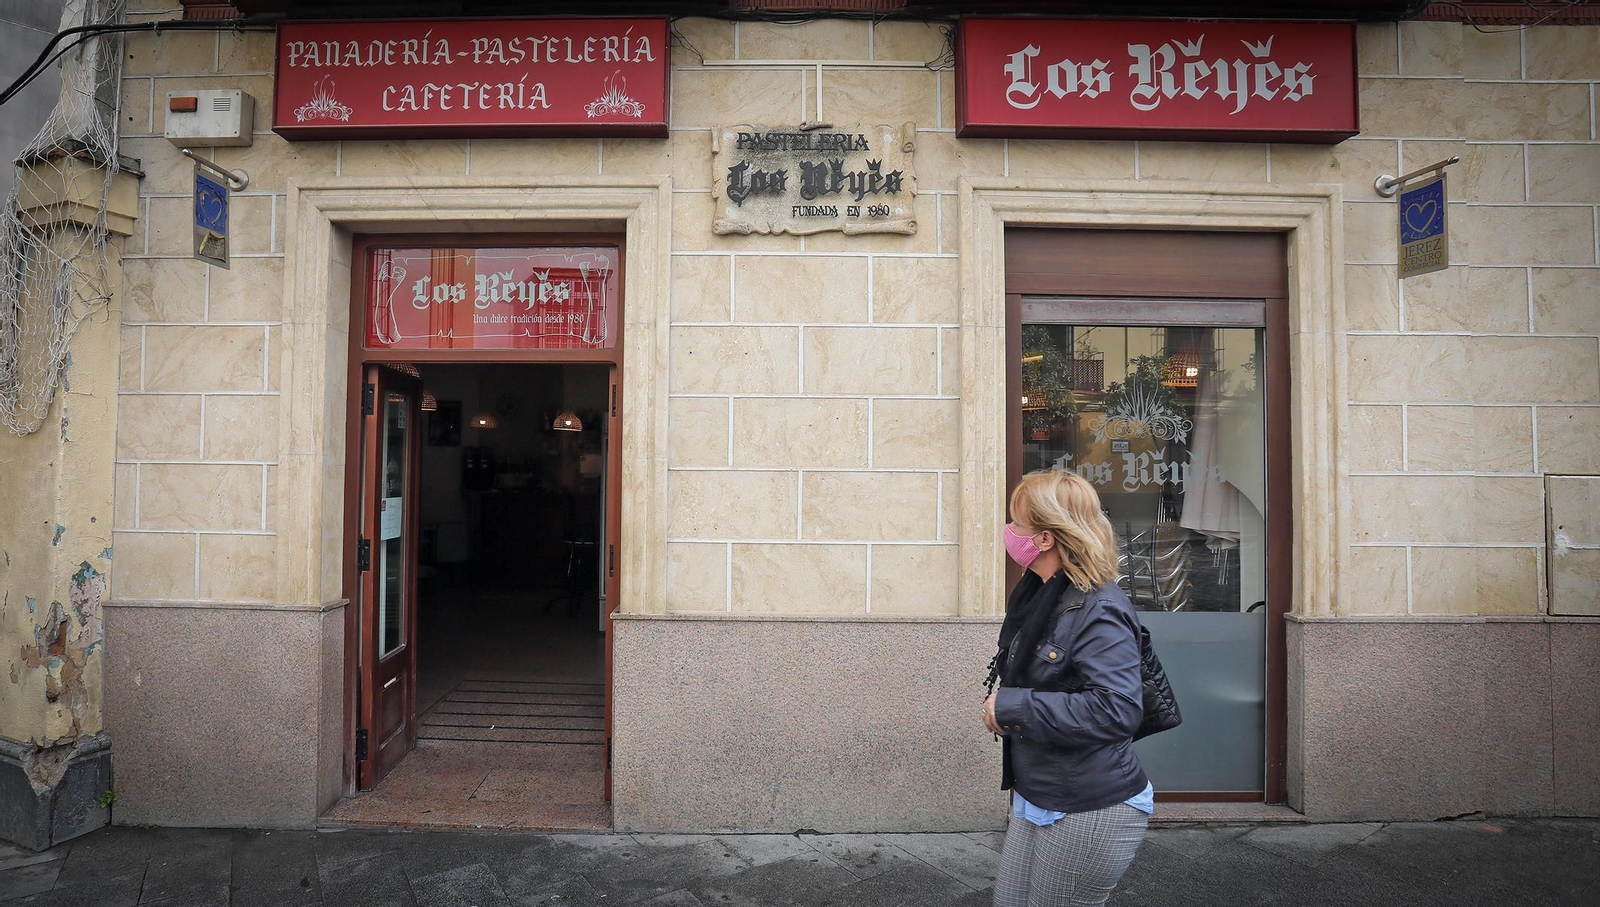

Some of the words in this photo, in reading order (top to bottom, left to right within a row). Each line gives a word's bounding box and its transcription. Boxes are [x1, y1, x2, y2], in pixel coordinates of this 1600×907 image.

[1004, 43, 1115, 110] Los
[1127, 33, 1317, 115] Reyes
[382, 72, 553, 112] CAFETERÍA
[736, 132, 870, 151] PASTELERIA
[726, 159, 790, 207] Los
[800, 158, 904, 202] Reyes
[792, 205, 839, 218] FUNDADA
[847, 205, 861, 218] EN
[867, 203, 890, 217] 1980
[1403, 238, 1441, 260] JEREZ
[1404, 251, 1442, 266] CENTRO
[412, 276, 468, 309] Los
[475, 268, 571, 310] Reyes
[473, 314, 488, 323] Una
[490, 313, 508, 323] dulce
[510, 313, 543, 324] tradición
[545, 314, 565, 323] desde
[567, 313, 585, 324] 1980
